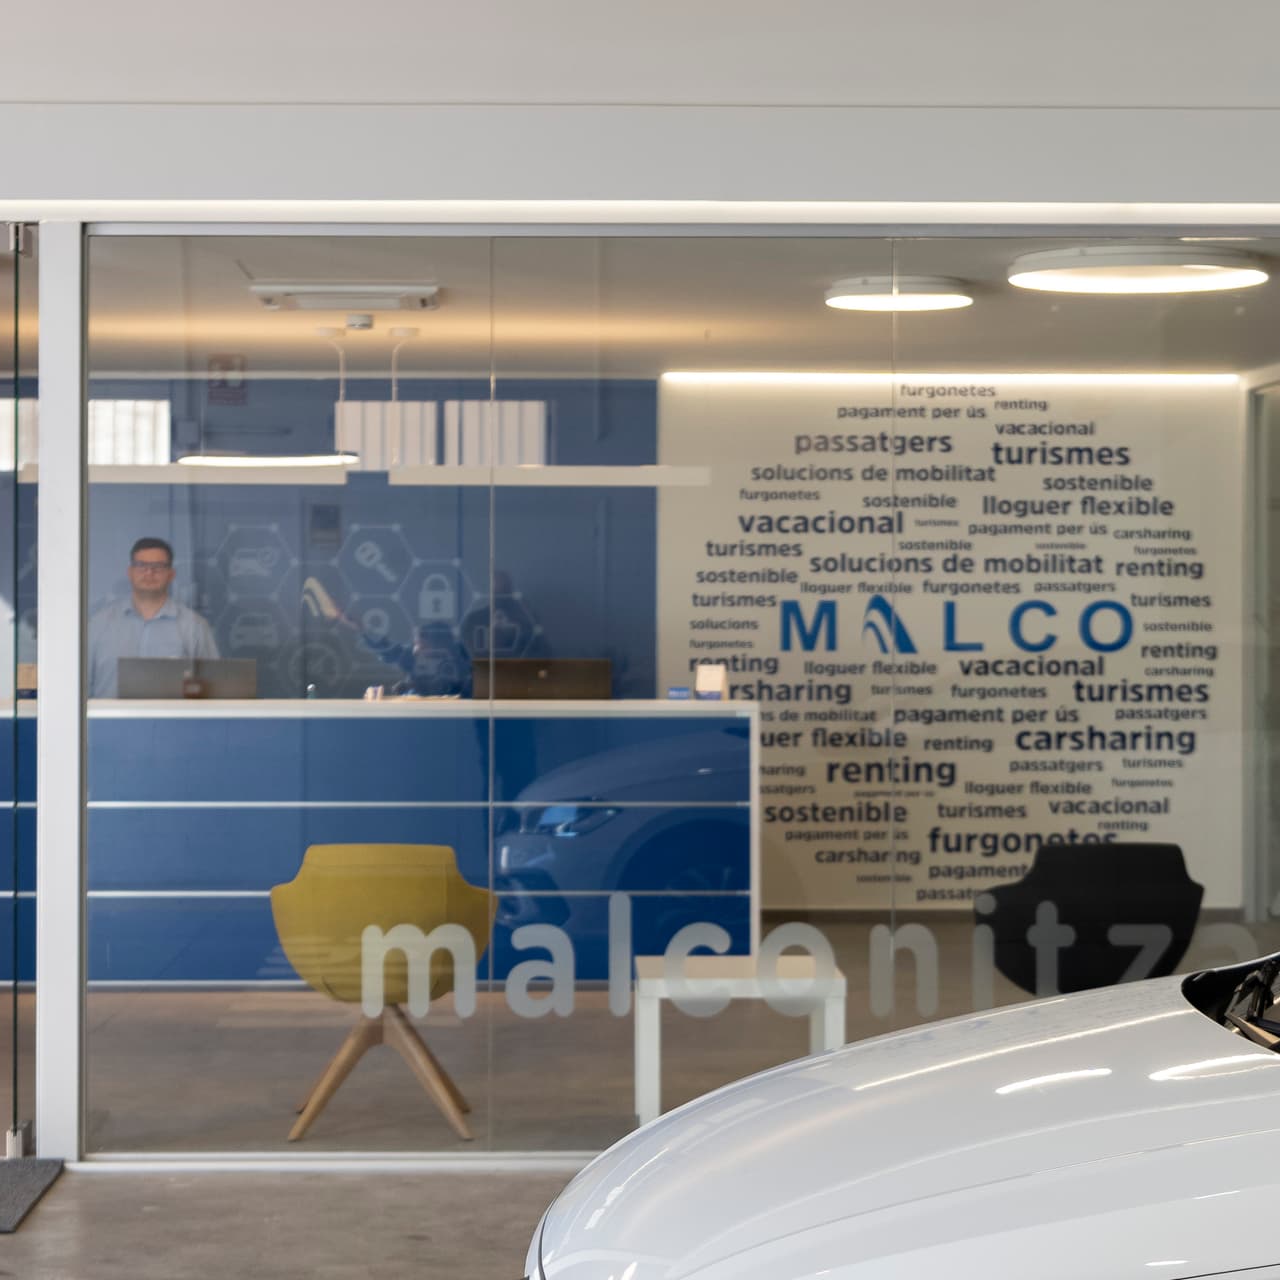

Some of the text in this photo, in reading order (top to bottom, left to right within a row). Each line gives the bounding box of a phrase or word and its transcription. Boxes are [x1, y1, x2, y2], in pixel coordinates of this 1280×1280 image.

[901, 384, 996, 399] furgonetes
[795, 433, 952, 455] passatgers
[992, 442, 1130, 466] turismes
[751, 465, 996, 482] solucions de mobilitat
[1043, 475, 1152, 491] sostenible
[862, 494, 956, 510] sostenible
[983, 496, 1174, 517] lloguer flexible
[738, 510, 903, 534] vacacional
[706, 540, 803, 557] turismes
[810, 550, 1103, 574] solucions de mobilitat
[1116, 558, 1205, 580] renting
[696, 568, 799, 584] sostenible
[922, 580, 1021, 597] furgonetes
[1034, 579, 1116, 594] passatgers
[692, 592, 777, 607] turismes
[1130, 593, 1212, 608] turismes
[780, 594, 1134, 653] MALCO
[1141, 643, 1218, 660] renting
[804, 660, 936, 677] lloguer flexible
[960, 655, 1104, 676] vacacional
[950, 684, 1047, 700] furgonetes
[1073, 679, 1209, 702] turismes
[803, 706, 877, 722] mobilitat
[893, 708, 1005, 725] pagament
[1011, 709, 1048, 725] per
[1115, 705, 1207, 723] passatgers
[811, 724, 907, 748] flexible
[924, 736, 994, 753] renting
[1015, 725, 1196, 755] carsharing
[827, 758, 957, 788] renting
[965, 781, 1026, 796] lloguer
[765, 802, 907, 823] sostenible
[937, 803, 1027, 818] turismes
[1049, 797, 1169, 815] vacacional
